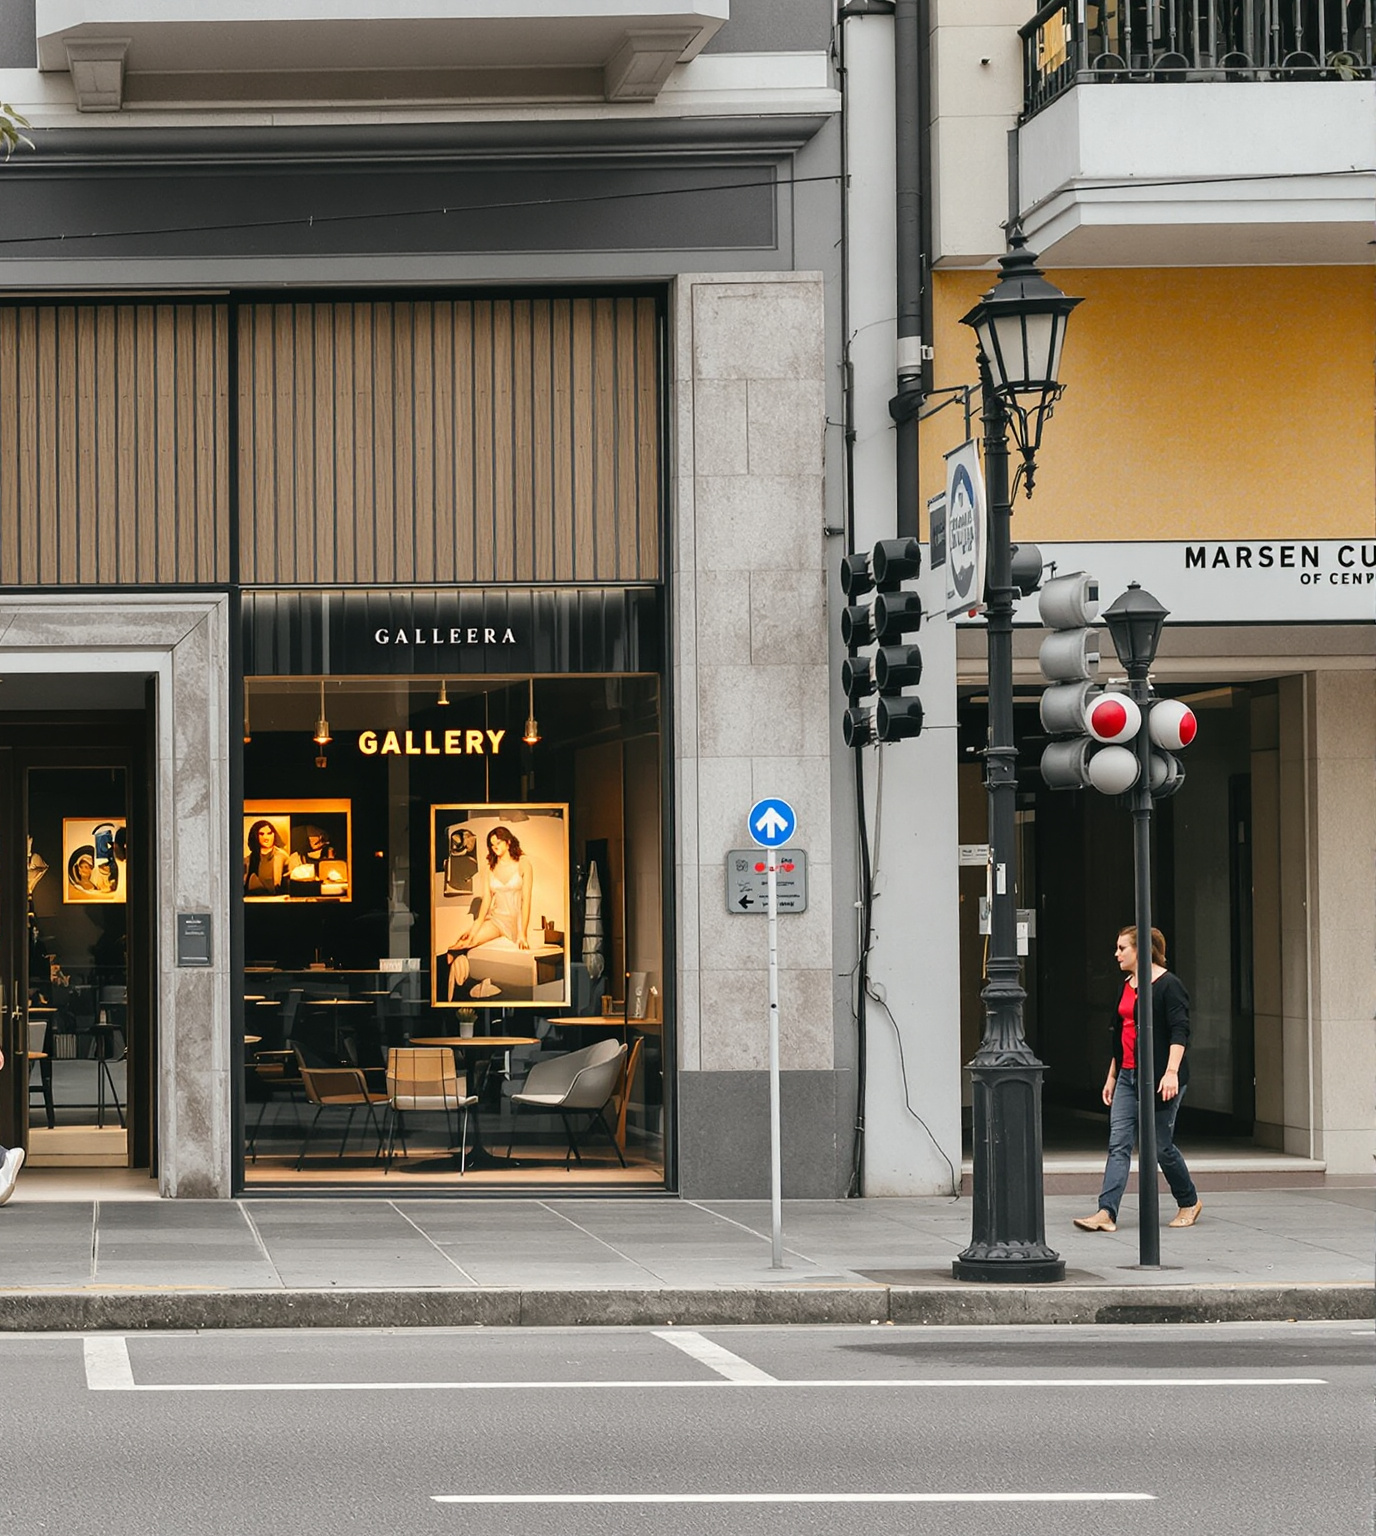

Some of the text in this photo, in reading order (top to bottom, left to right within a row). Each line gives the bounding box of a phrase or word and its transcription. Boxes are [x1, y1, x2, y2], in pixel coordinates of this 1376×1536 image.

[1185, 545, 1376, 569] MARSEN CU
[1300, 573, 1322, 585] OF
[374, 628, 517, 645] GALLEERA
[358, 729, 506, 755] GALLERY
